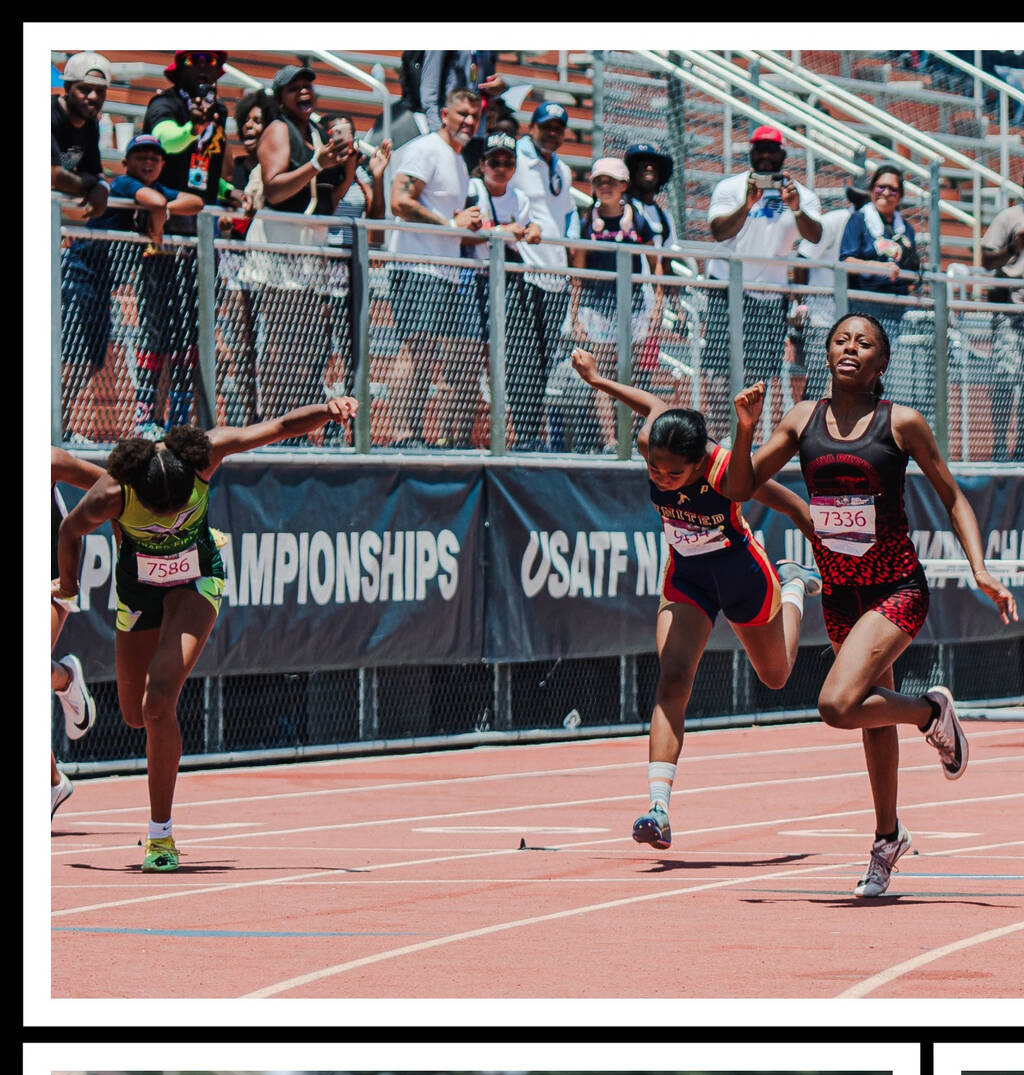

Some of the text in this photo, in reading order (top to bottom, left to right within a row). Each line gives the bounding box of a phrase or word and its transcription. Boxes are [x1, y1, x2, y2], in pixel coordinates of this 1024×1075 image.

[819, 510, 867, 528] 7336
[146, 557, 190, 578] 7586
[218, 528, 461, 606] AMPIONSHIPS
[521, 529, 628, 599] USATF
